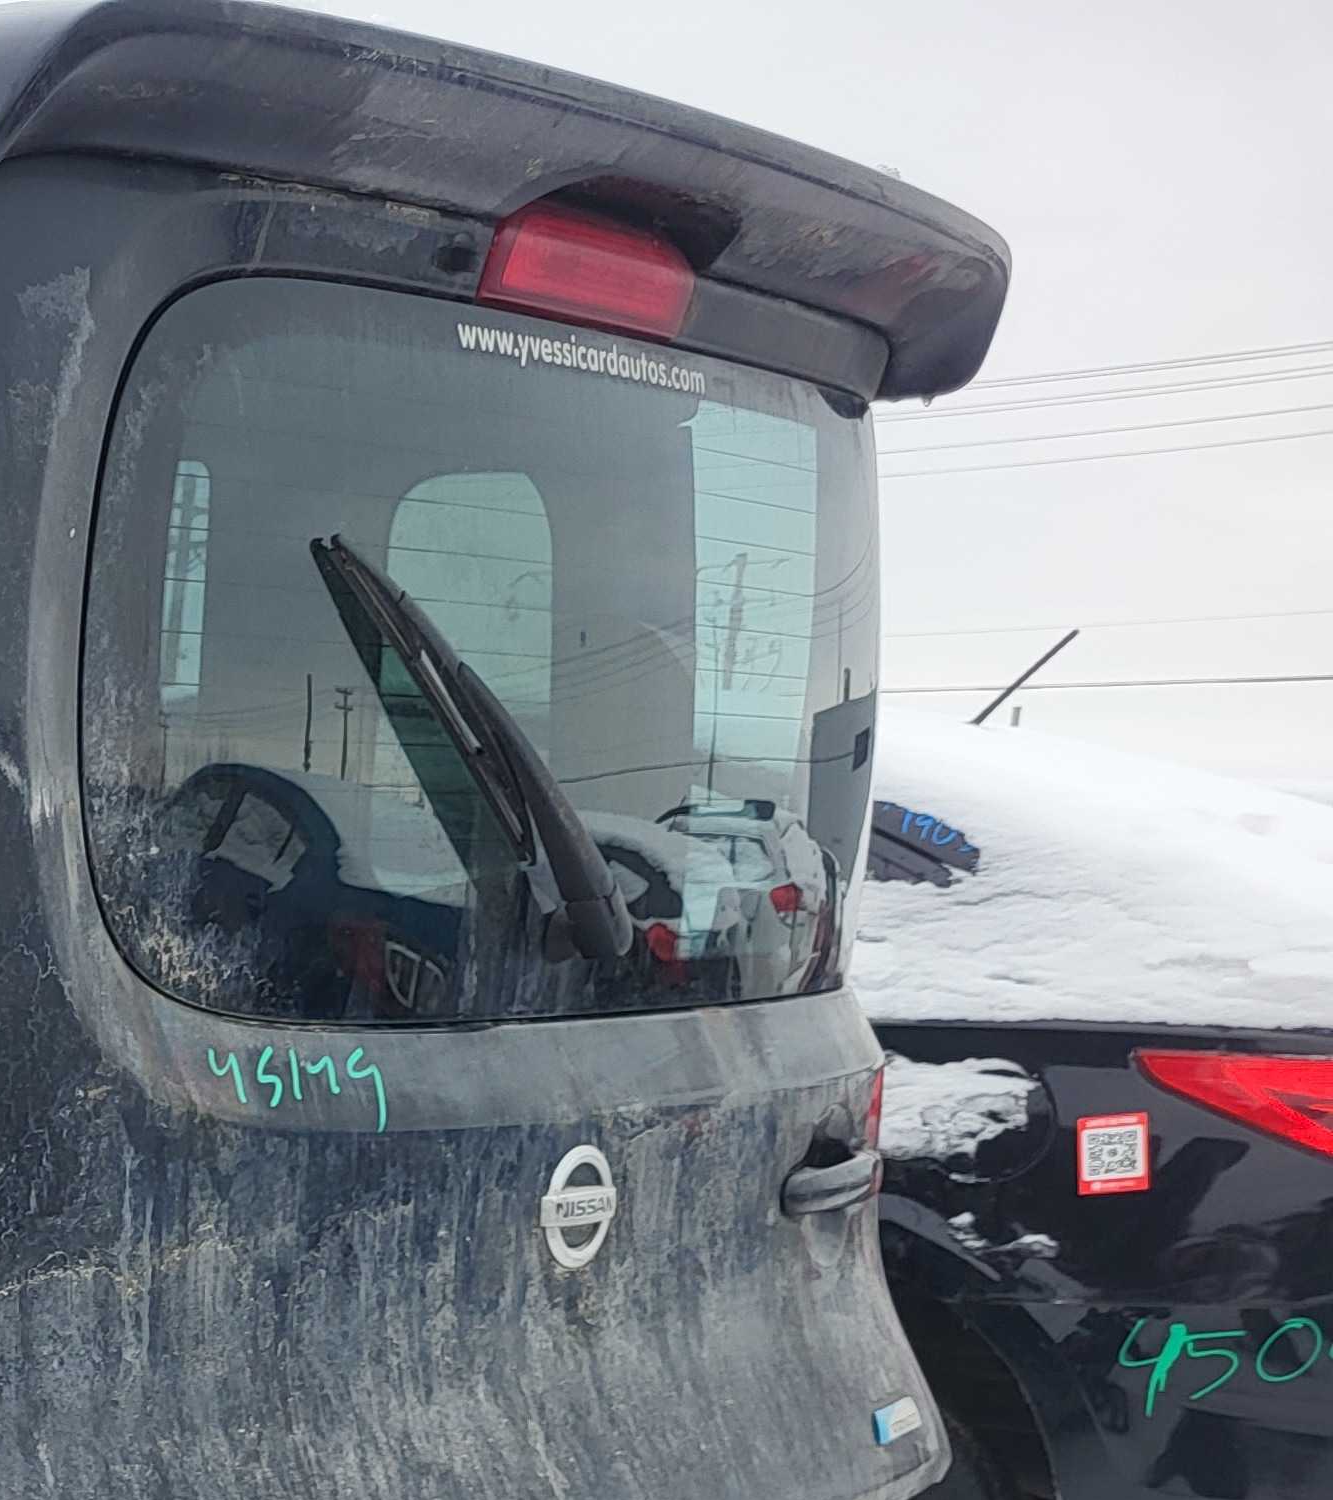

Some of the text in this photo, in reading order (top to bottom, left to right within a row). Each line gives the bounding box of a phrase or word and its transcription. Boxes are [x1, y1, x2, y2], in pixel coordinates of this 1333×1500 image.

[456, 322, 706, 395] www.yvessicardautos.com
[555, 1196, 613, 1218] NISSAN
[1118, 1316, 1333, 1419] 450
